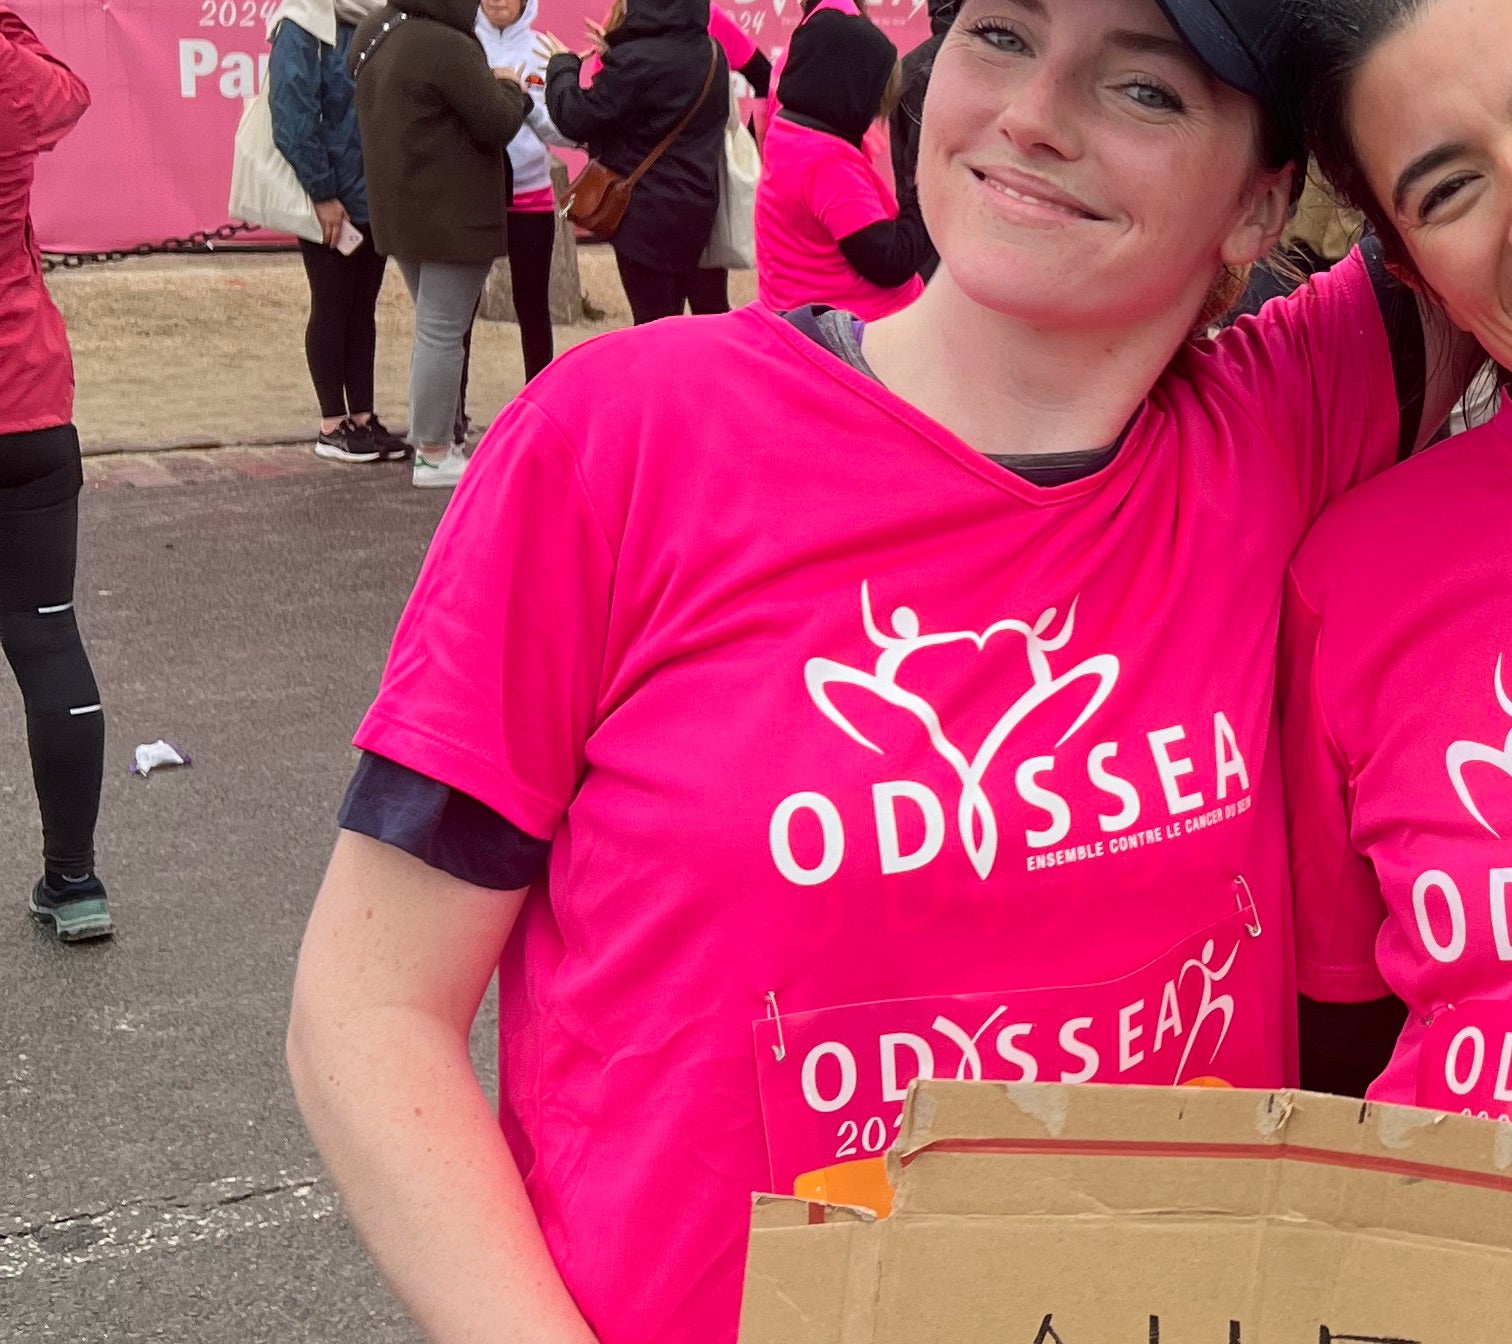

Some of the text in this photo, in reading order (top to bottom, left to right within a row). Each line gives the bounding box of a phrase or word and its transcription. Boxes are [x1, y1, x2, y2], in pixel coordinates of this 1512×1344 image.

[768, 709, 1251, 886] ODYSSEA
[1025, 840, 1105, 873] ENSEMBLE
[1108, 826, 1163, 855] CONTRE
[1166, 821, 1182, 840] LE
[1184, 806, 1224, 834] CANCER
[800, 979, 1184, 1113] ODYSSEA
